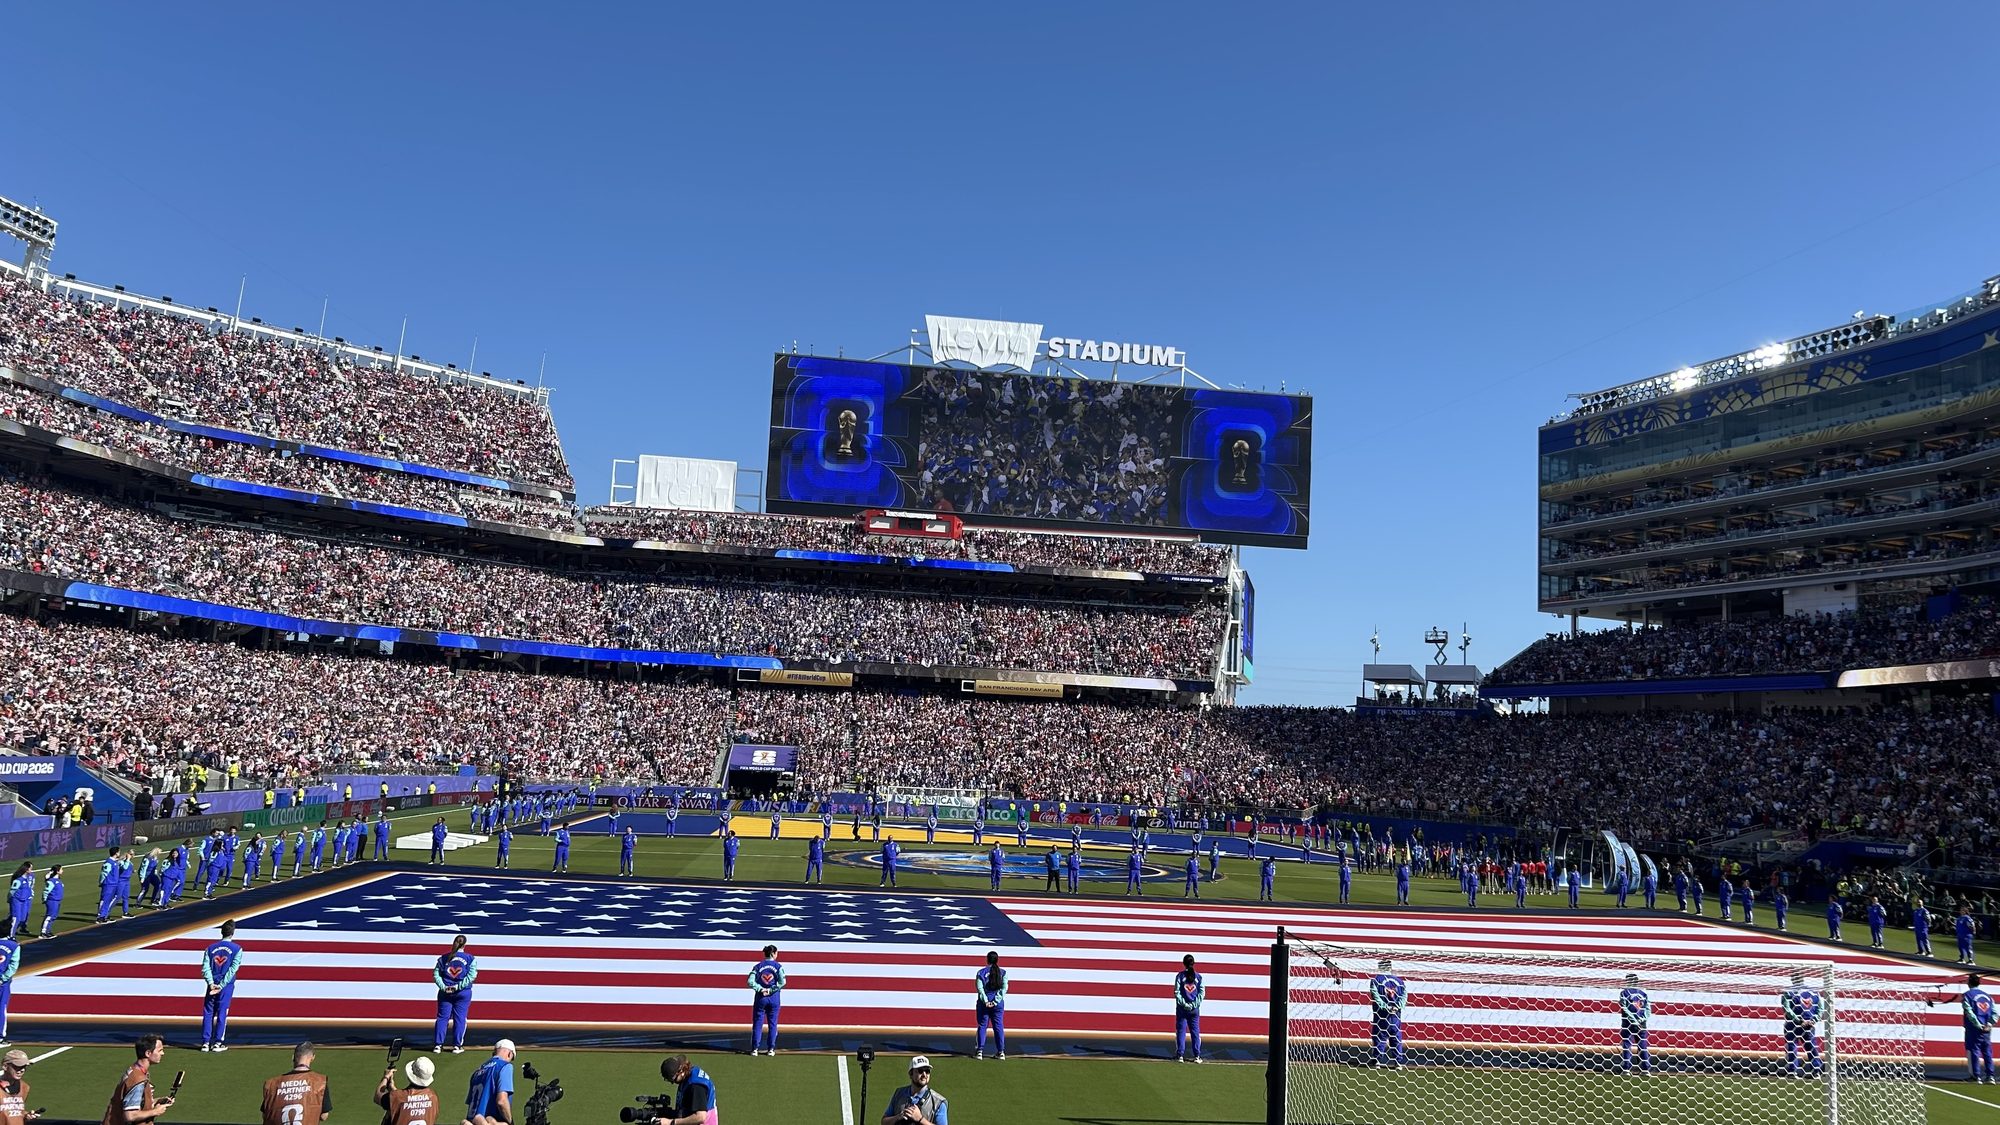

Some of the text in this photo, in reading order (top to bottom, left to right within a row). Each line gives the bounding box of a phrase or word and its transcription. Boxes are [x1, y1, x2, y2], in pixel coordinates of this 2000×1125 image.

[1048, 337, 1176, 367] STADIUM
[787, 673, 826, 682] #FIFAWorldCup
[13, 762, 28, 775] CUP
[28, 762, 54, 775] 2026
[758, 801, 789, 813] VISA
[269, 807, 305, 826] aramco
[1877, 847, 1894, 855] WORLD
[281, 1079, 308, 1088] MEDIA
[277, 1085, 311, 1095] PARTNER
[284, 1093, 303, 1101] 4296
[407, 1094, 429, 1102] MEDIA
[403, 1101, 432, 1110] PARTNER
[411, 1108, 426, 1116] 0790
